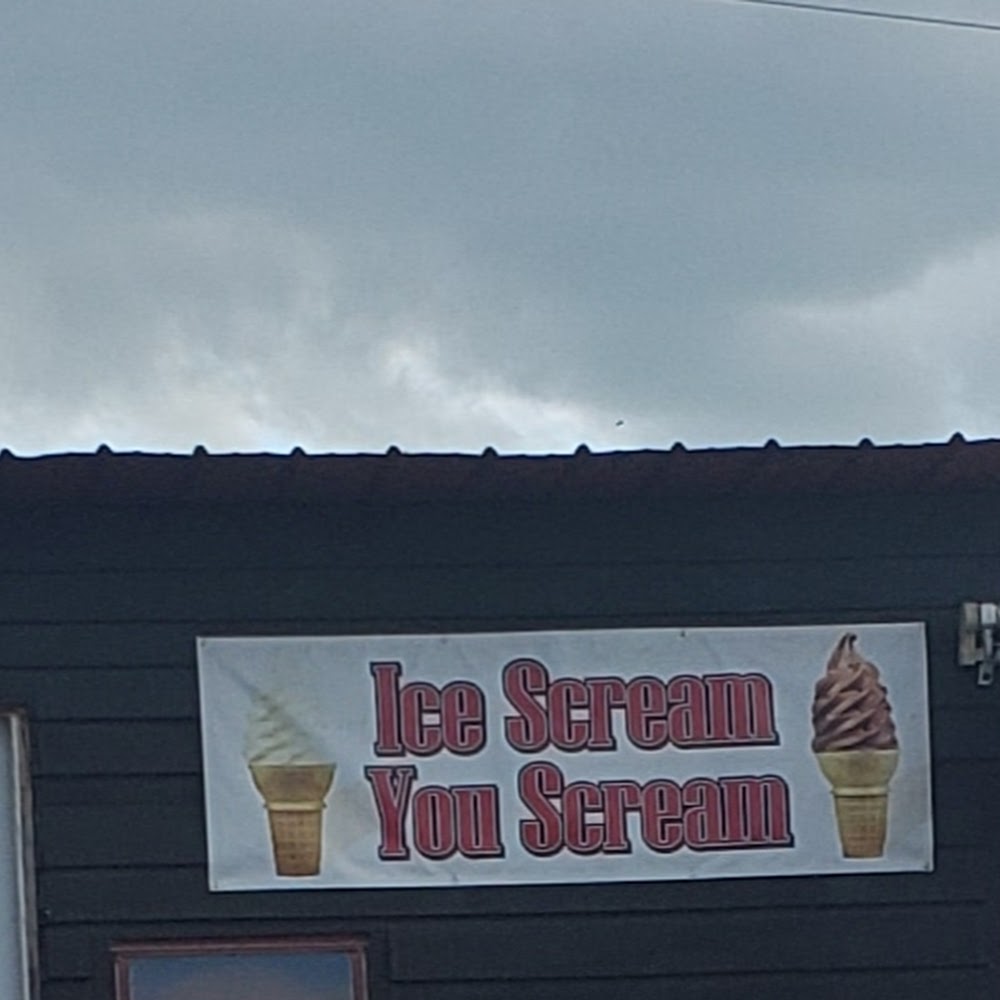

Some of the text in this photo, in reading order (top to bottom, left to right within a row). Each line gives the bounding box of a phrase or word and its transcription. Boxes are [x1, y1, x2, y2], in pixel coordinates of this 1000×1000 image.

[369, 658, 780, 757] Ice Scream
[365, 760, 794, 860] You Scream
